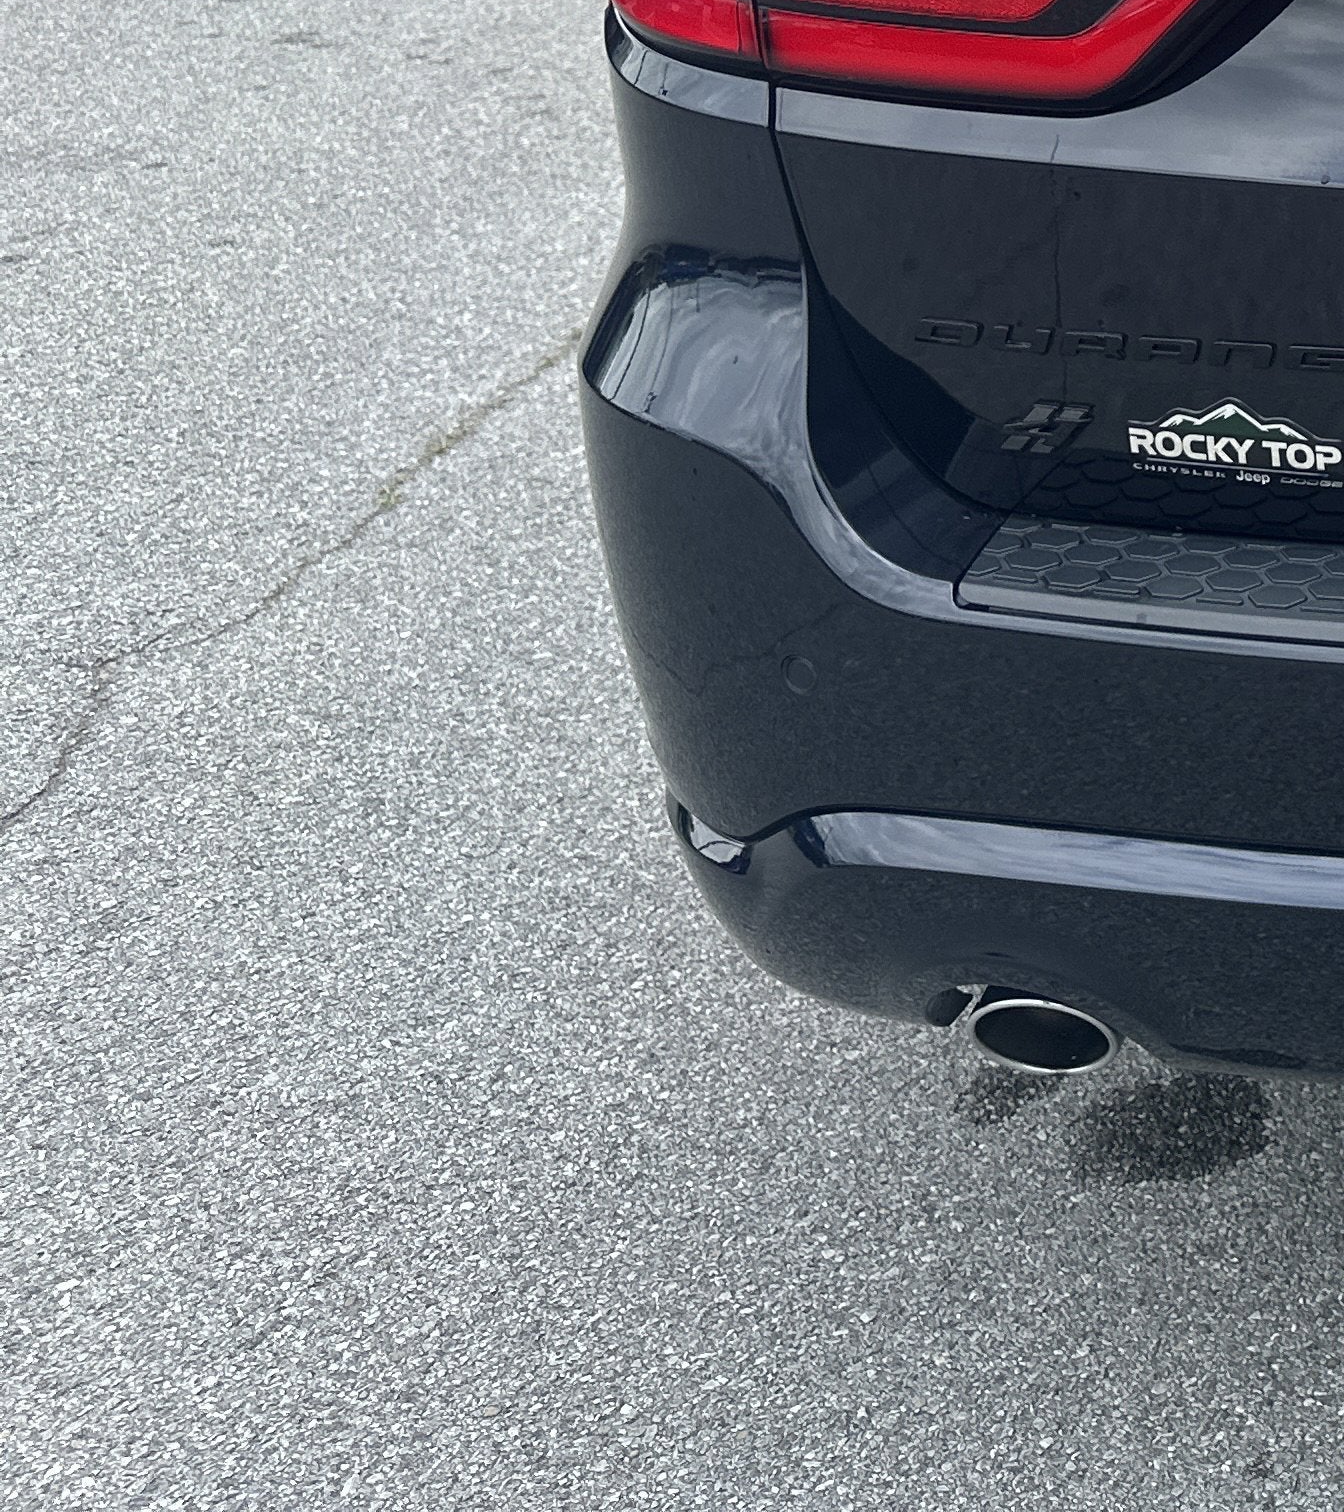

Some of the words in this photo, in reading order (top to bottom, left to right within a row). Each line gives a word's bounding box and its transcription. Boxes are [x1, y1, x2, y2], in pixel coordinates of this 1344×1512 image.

[1128, 427, 1255, 464] ROCKY
[1261, 440, 1343, 471] TOP
[1132, 462, 1227, 479] CHRYSLER
[1235, 469, 1271, 485] Jeep
[1280, 476, 1344, 488] DODGE
